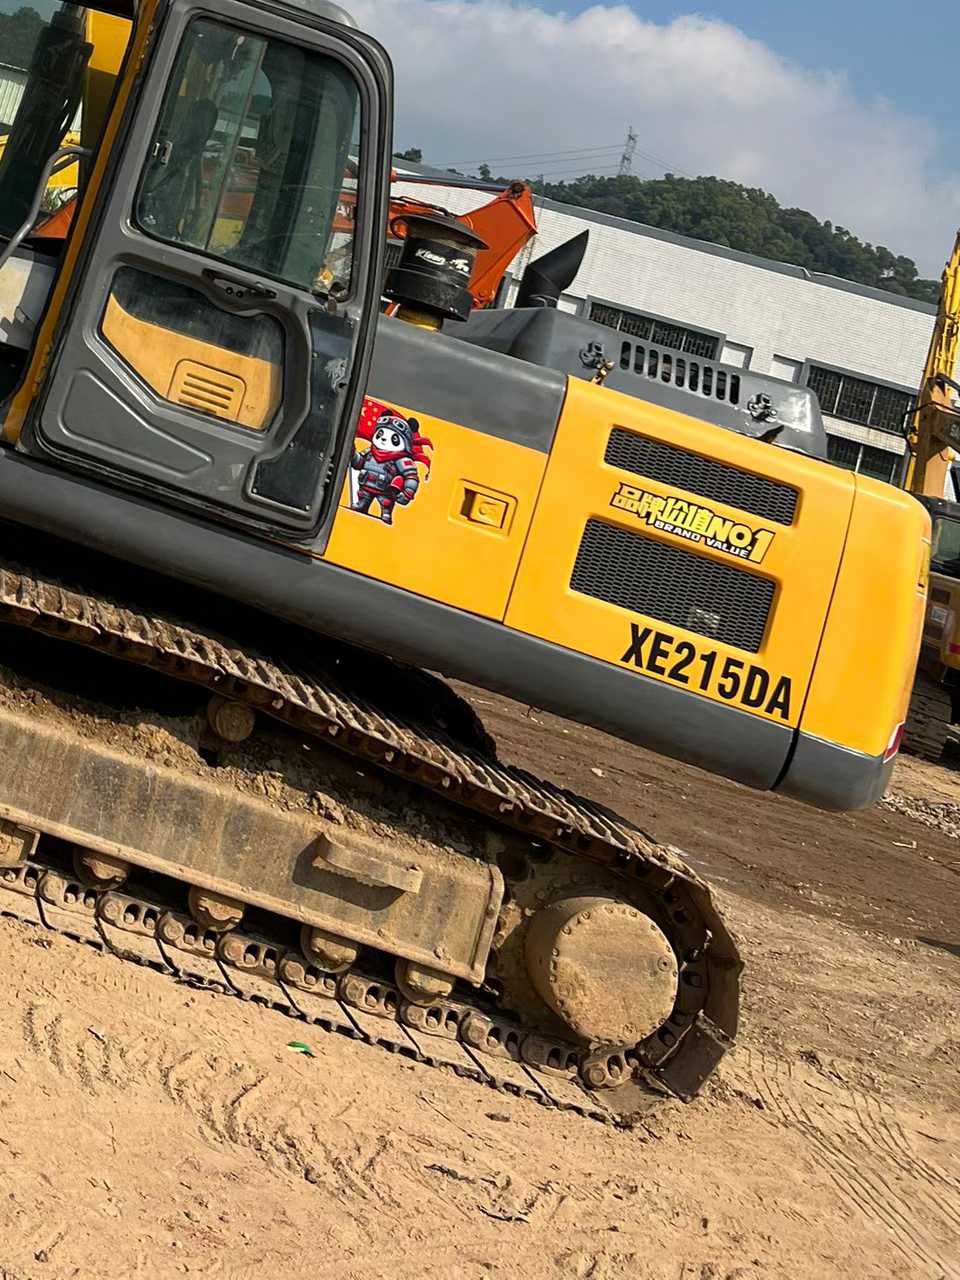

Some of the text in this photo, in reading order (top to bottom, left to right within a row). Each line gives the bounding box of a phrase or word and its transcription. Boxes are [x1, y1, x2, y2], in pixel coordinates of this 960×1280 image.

[654, 520, 750, 559] BRAND VALUE
[620, 623, 792, 720] XE215DA
